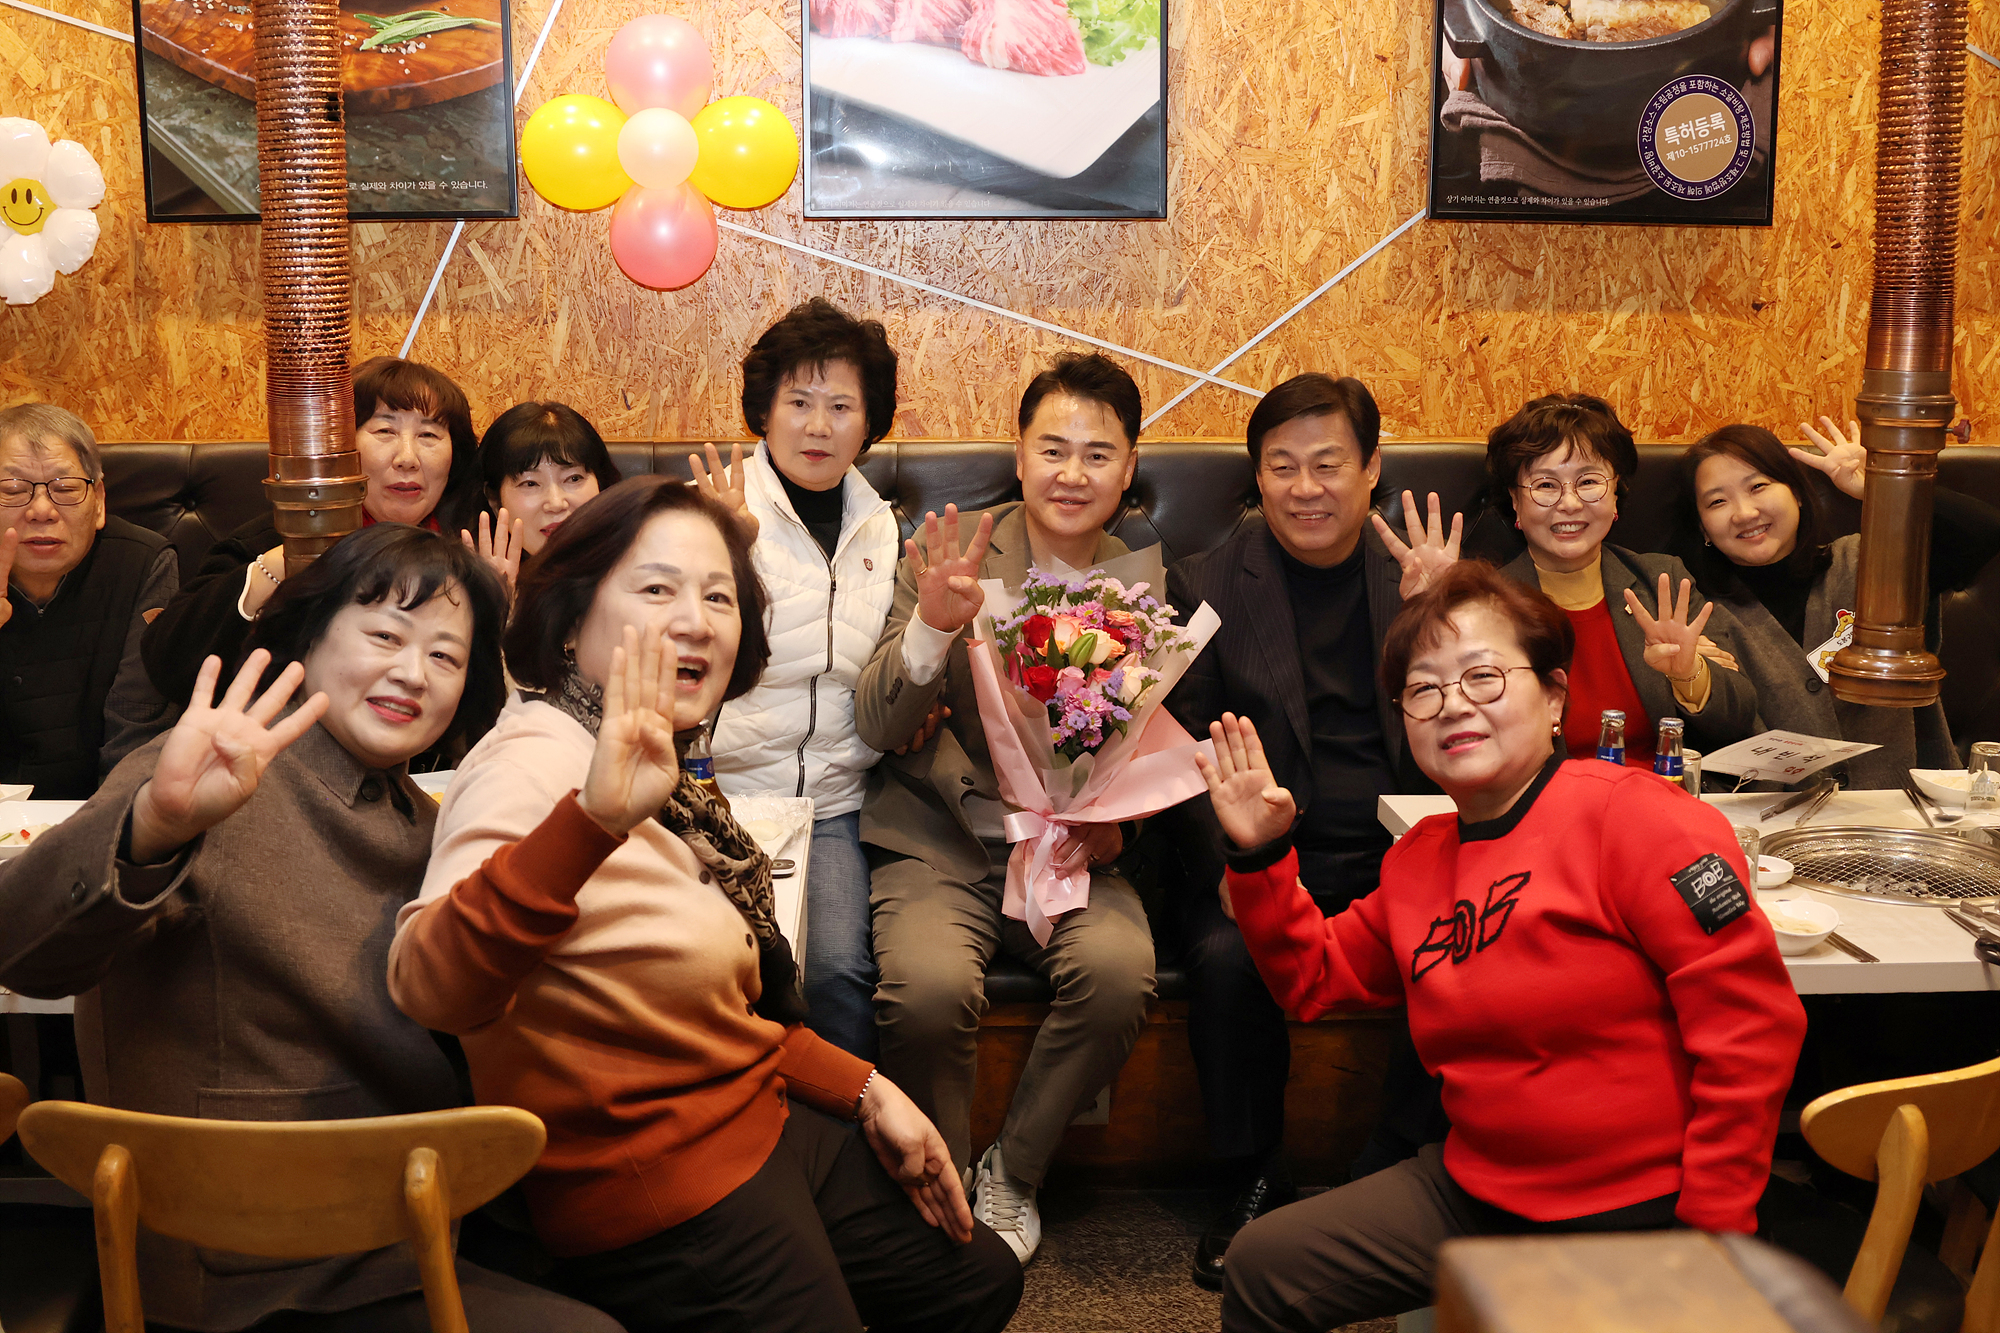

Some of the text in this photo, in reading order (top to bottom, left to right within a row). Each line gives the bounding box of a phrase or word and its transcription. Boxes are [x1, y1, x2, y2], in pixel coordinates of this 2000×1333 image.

[1642, 79, 1751, 196] 간장소스 조림공정을 포함하는 소갈비탕 제조방법 및 그 제조방법에 의해 제조된 소갈비탕
[1664, 112, 1726, 145] 특허등록
[1666, 134, 1733, 161] 제10-1577724호
[360, 181, 387, 191] 실제와
[389, 181, 416, 190] 차이가
[418, 181, 436, 190] 있을
[439, 181, 448, 190] 수
[450, 180, 489, 190] 있습니다.
[1446, 195, 1459, 204] 상기
[1461, 195, 1487, 204] 이미지는
[1521, 196, 1539, 205] 실제와
[1541, 196, 1560, 205] 차이가
[1561, 197, 1574, 206] 있을
[1575, 197, 1582, 206] 수
[1584, 198, 1610, 206] 있습니다.
[1691, 861, 1724, 898] BOB
[1411, 870, 1531, 984] BOB
